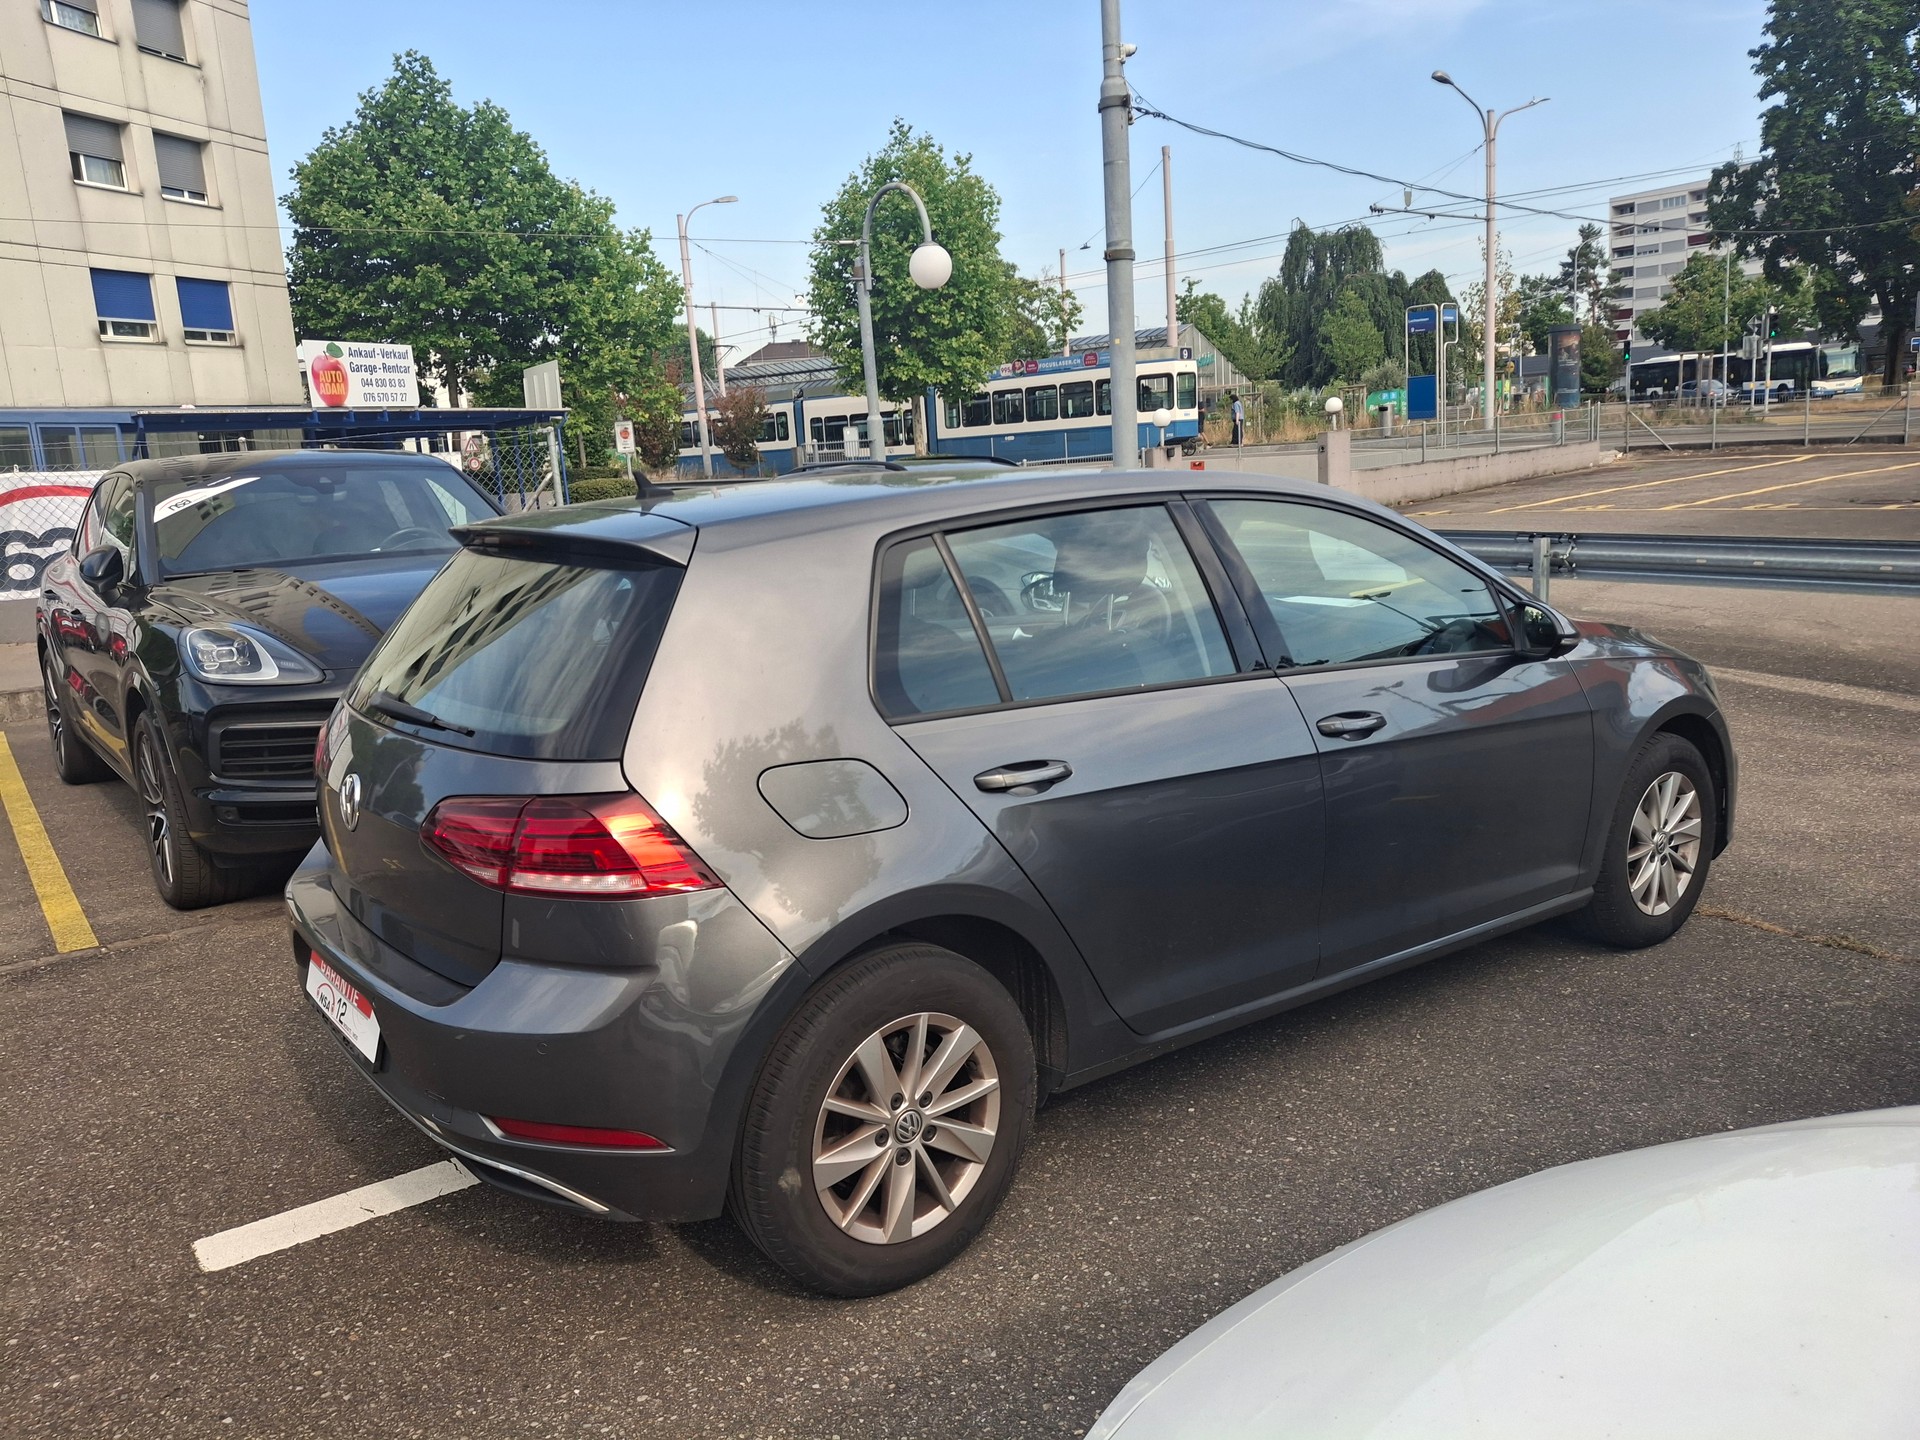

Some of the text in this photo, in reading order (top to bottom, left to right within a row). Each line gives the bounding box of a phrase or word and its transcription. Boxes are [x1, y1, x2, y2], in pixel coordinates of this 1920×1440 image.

[1182, 348, 1188, 360] 9
[320, 370, 342, 383] AUTO
[320, 383, 346, 395] ADAM
[361, 378, 406, 388] 044 830 83 83
[363, 392, 407, 402] 076 570 57 27
[320, 993, 331, 1012] NSA
[335, 997, 348, 1025] 12
